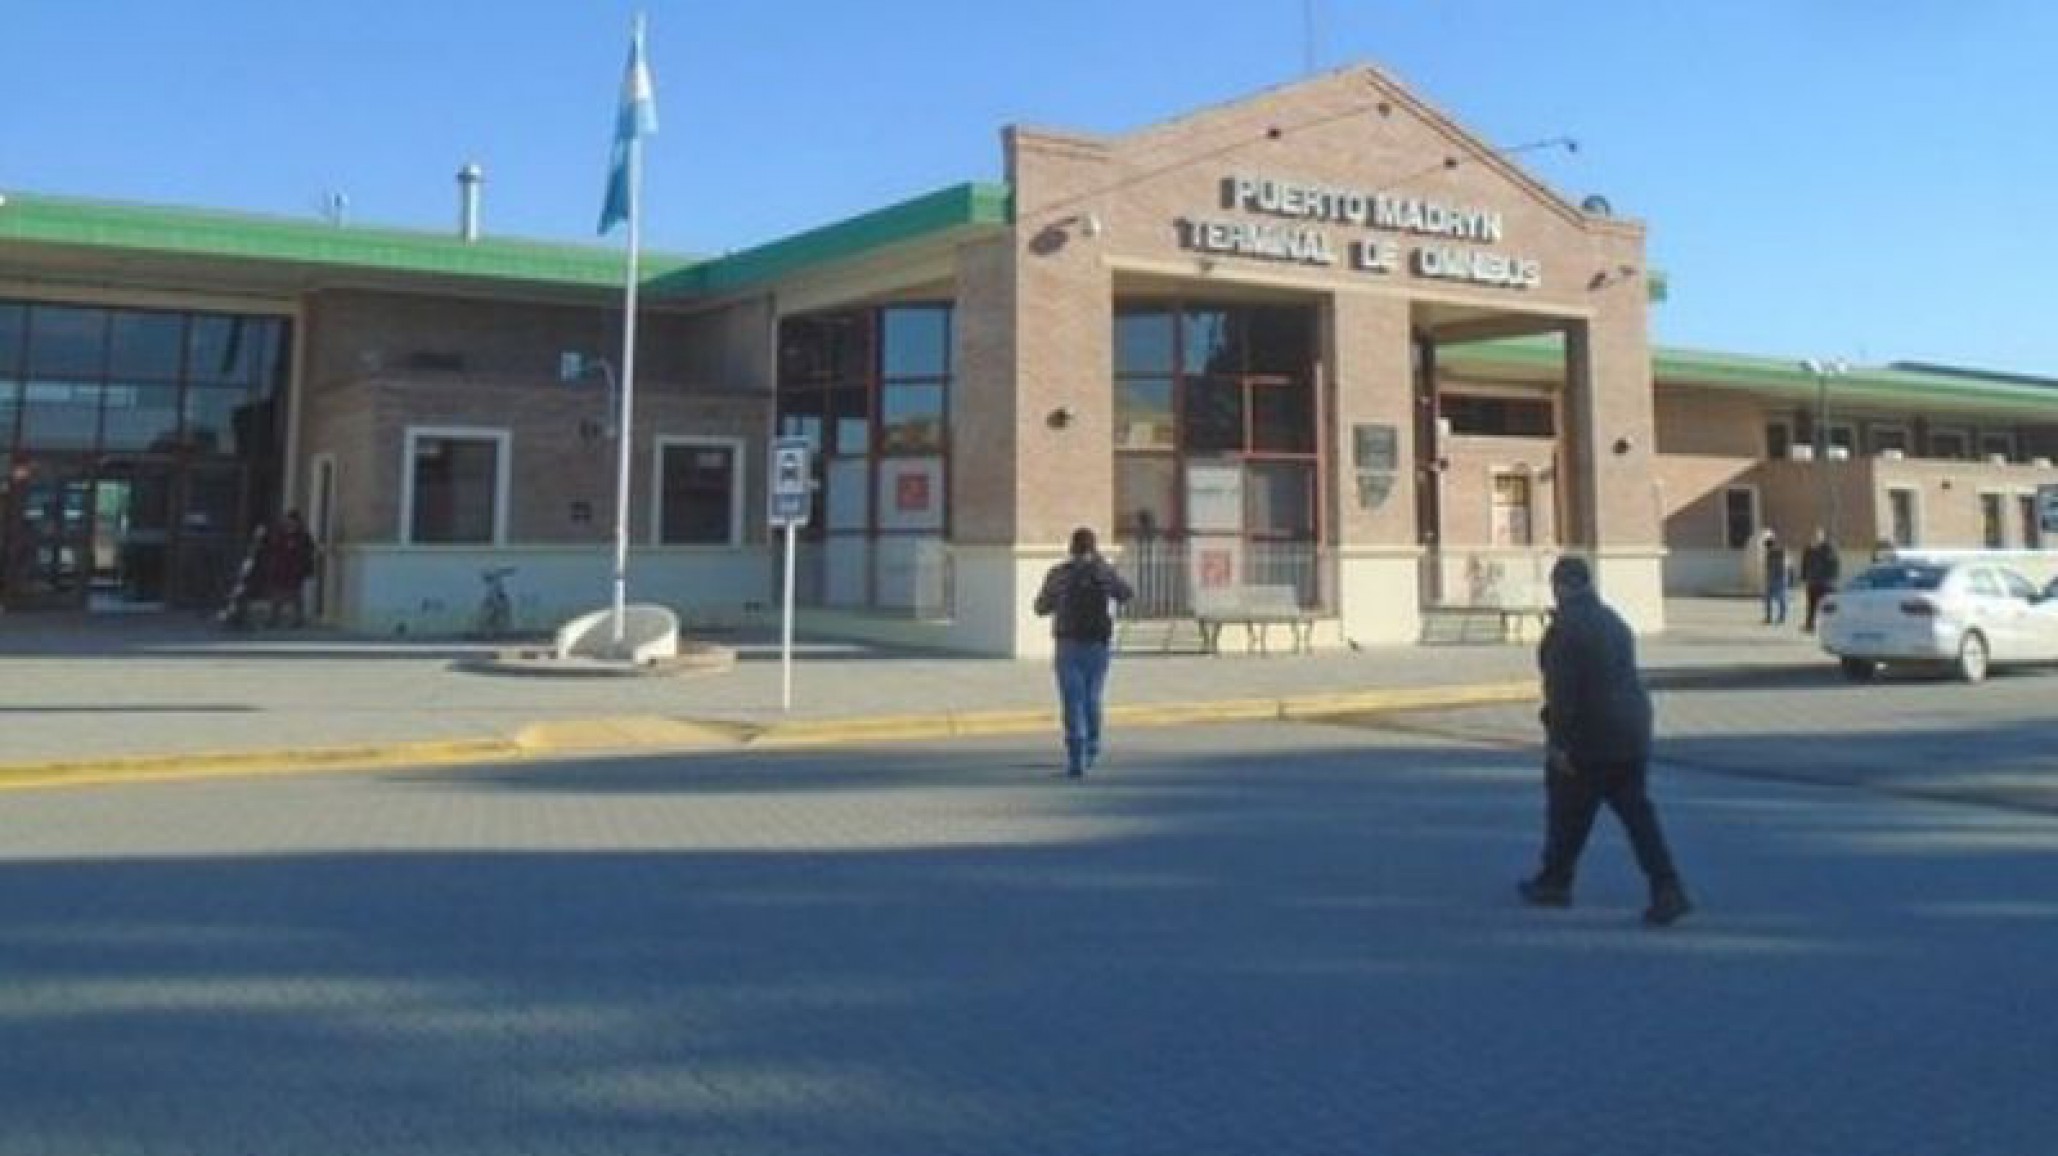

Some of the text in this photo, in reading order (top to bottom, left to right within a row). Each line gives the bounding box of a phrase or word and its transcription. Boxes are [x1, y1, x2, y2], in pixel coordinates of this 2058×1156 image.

[1224, 175, 1503, 243] PUERTO MADRYN
[1178, 218, 1542, 288] TERMINAL DE OMNIBUS
